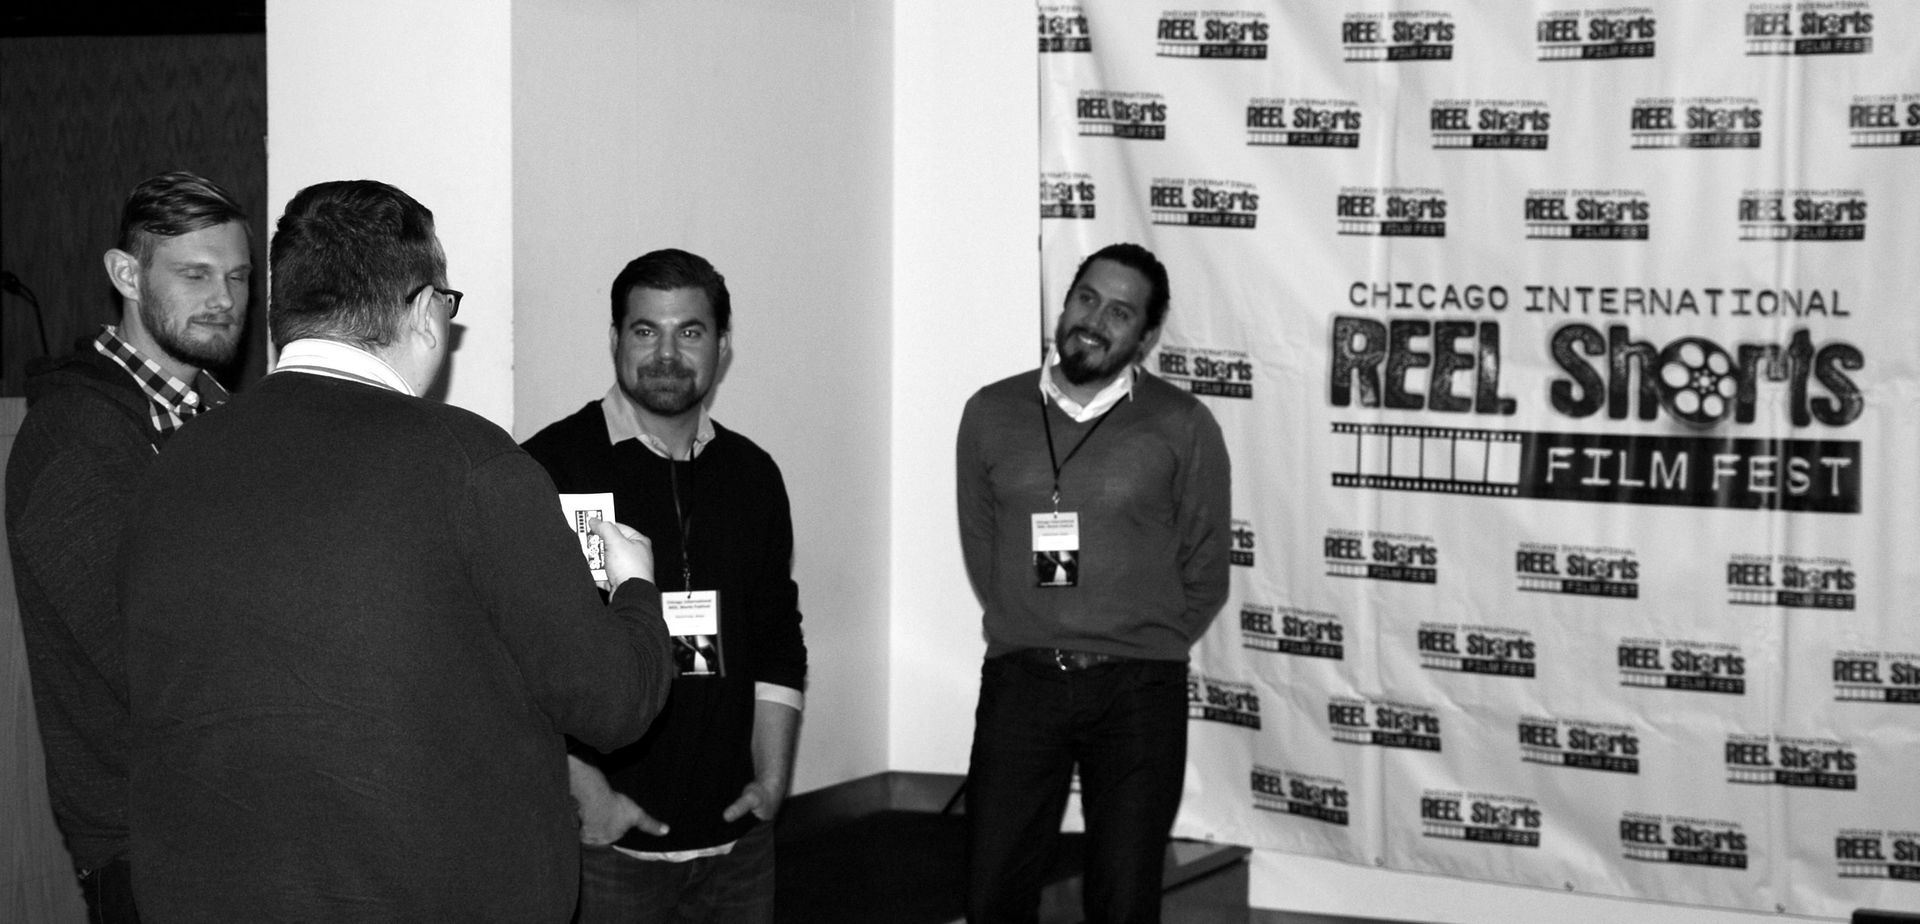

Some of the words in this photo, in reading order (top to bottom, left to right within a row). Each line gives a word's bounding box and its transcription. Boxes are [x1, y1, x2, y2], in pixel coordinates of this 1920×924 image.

[1157, 19, 1198, 40] REEL
[1205, 19, 1269, 44] Shorts
[1394, 21, 1455, 45] Shorts
[1538, 20, 1582, 42] REEL
[1589, 17, 1655, 44] Shorts
[1801, 11, 1873, 38] Shorts
[1247, 107, 1286, 128] REEL
[1293, 108, 1361, 132] Shorts
[1432, 108, 1471, 130] REEL
[1478, 109, 1550, 134] Shorts
[1631, 107, 1676, 129] REEL
[1686, 106, 1762, 133] Shorts
[1150, 186, 1186, 208] REEL
[1192, 187, 1259, 212] Shorts
[1386, 196, 1446, 221] Shorts
[1525, 198, 1569, 220] REEL
[1576, 199, 1649, 225] Shorts
[1793, 199, 1867, 225] Shorts
[1348, 281, 1509, 311] CHICAGO
[1524, 285, 1850, 317] INTERNATIONAL
[1159, 352, 1188, 375] REEL
[1193, 356, 1252, 381] Shorts
[1330, 315, 1518, 416] REEL
[1550, 322, 1864, 431] Shorts
[1546, 446, 1689, 491] FILM
[1711, 453, 1853, 497] FEST
[1325, 537, 1366, 560] REEL
[1372, 540, 1437, 566] Shorts
[1517, 550, 1559, 574] REEL
[1567, 554, 1638, 580] Shorts
[1727, 563, 1774, 586] REEL
[1782, 564, 1856, 593] Shorts
[1241, 610, 1276, 634] REEL
[1283, 615, 1343, 641] Shorts
[1418, 630, 1459, 653] REEL
[1466, 634, 1535, 659] Shorts
[1618, 646, 1664, 670] REEL
[1671, 649, 1745, 676] Shorts
[1833, 660, 1882, 684] REEL
[1329, 703, 1369, 726] REEL
[1376, 706, 1440, 732] Shorts
[1519, 722, 1561, 748] REEL
[1568, 727, 1639, 755] Shorts
[1726, 742, 1772, 765] REEL
[1779, 745, 1857, 771] Shorts
[1252, 770, 1284, 796] REEL
[1290, 778, 1348, 807] Shorts
[1421, 797, 1463, 822] REEL
[1471, 802, 1541, 828] Shorts
[1621, 819, 1667, 845] REEL
[1672, 825, 1747, 850] Shorts
[1836, 837, 1886, 860] REEL
